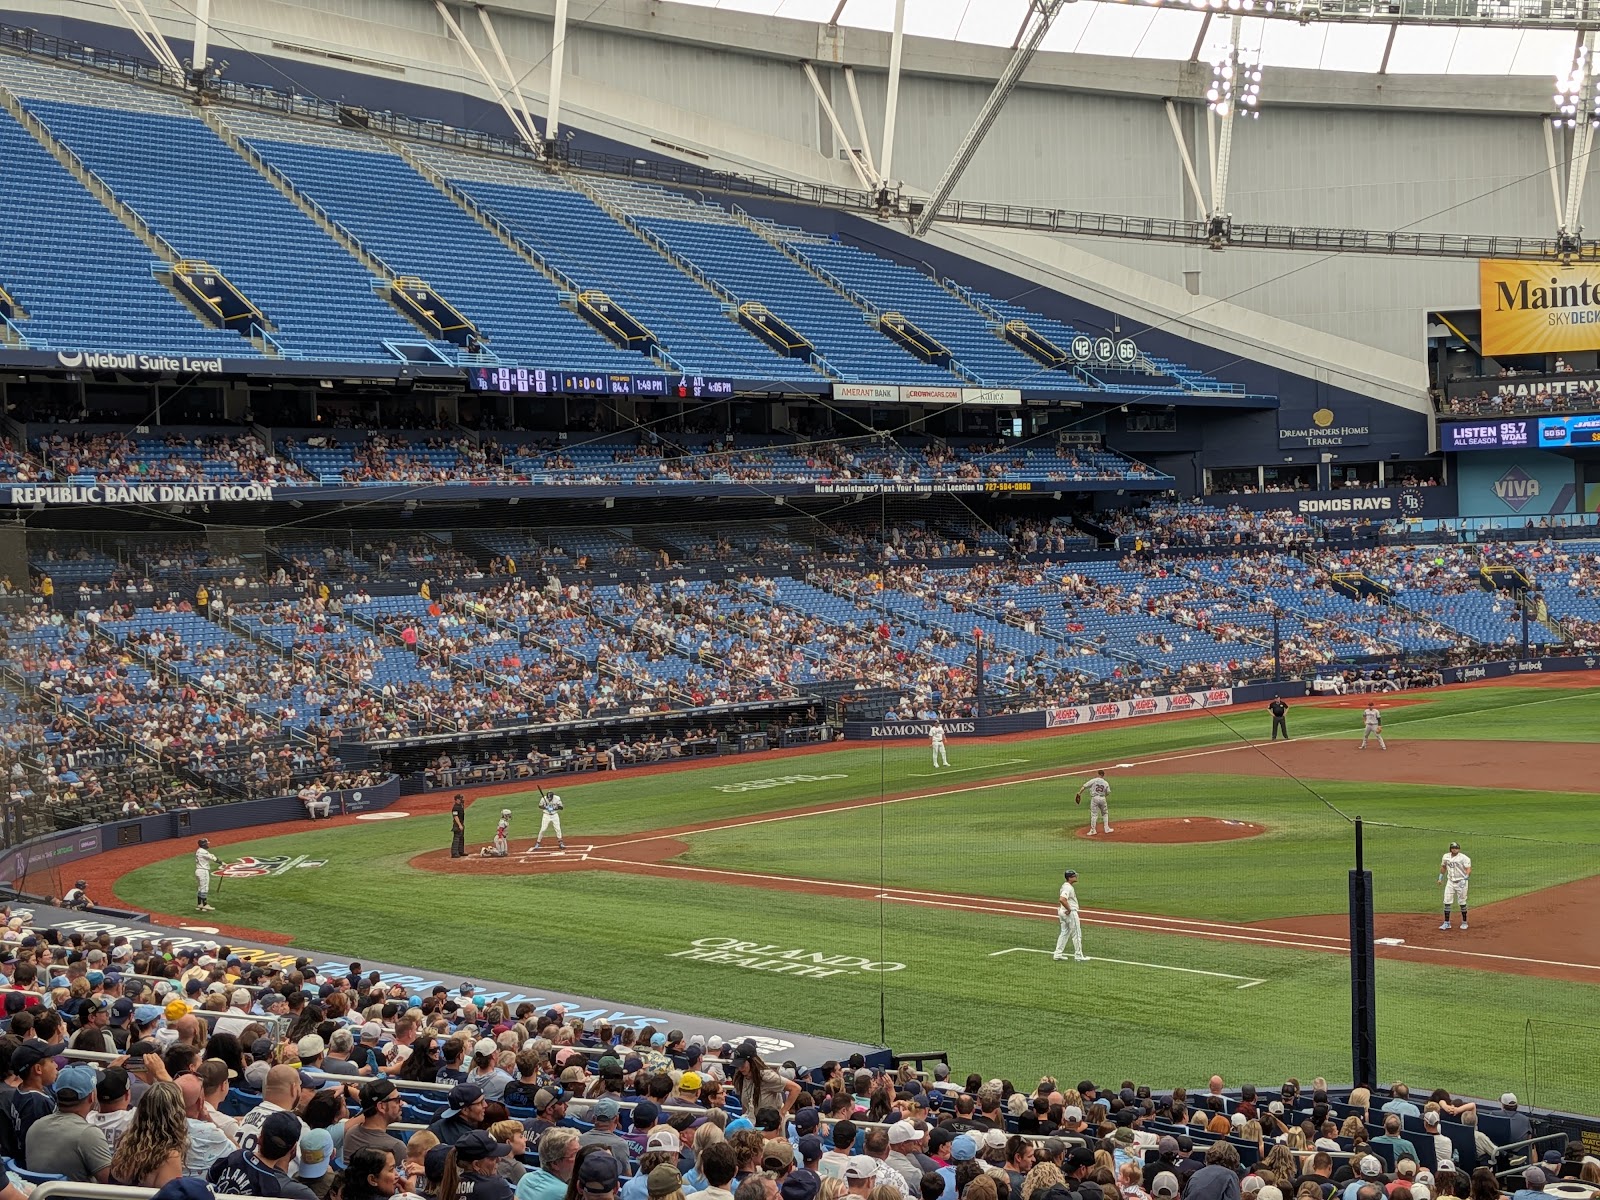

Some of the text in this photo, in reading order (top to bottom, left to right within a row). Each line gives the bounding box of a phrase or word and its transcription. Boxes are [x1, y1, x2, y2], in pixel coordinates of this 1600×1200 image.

[1075, 341, 1089, 356] 42
[1099, 342, 1110, 357] 12
[1120, 343, 1134, 358] 66
[84, 352, 223, 373] Webull Suite Level
[491, 372, 499, 385] R
[510, 373, 517, 385] H
[529, 374, 535, 386] E
[612, 382, 630, 393] 84.4
[652, 381, 662, 391] PM
[722, 382, 732, 393] PM
[841, 387, 892, 397] AMERANT BANK
[909, 390, 958, 399] CROWNCARS.COM
[1279, 426, 1369, 438] DREAM FINDERS HOMES
[1453, 426, 1497, 439] LISTEN
[1500, 422, 1527, 434] 95.7
[1305, 437, 1343, 446] TERRACE
[1454, 438, 1467, 446] ALL
[1468, 437, 1497, 445] SEASON
[1501, 433, 1527, 441] WDAE
[814, 484, 834, 493] Need
[835, 484, 878, 493] Assistance?
[896, 484, 912, 492] Your
[933, 483, 946, 491] and
[947, 483, 975, 491] Location
[1494, 480, 1539, 497] VIVA
[11, 486, 273, 503] REPUBLIC BANK DRAFT ROOM
[1299, 497, 1391, 512] SOMOS RAYS
[870, 725, 932, 737] RAYMOND
[690, 937, 907, 972] ORLANDO
[663, 948, 850, 979] HEALTH
